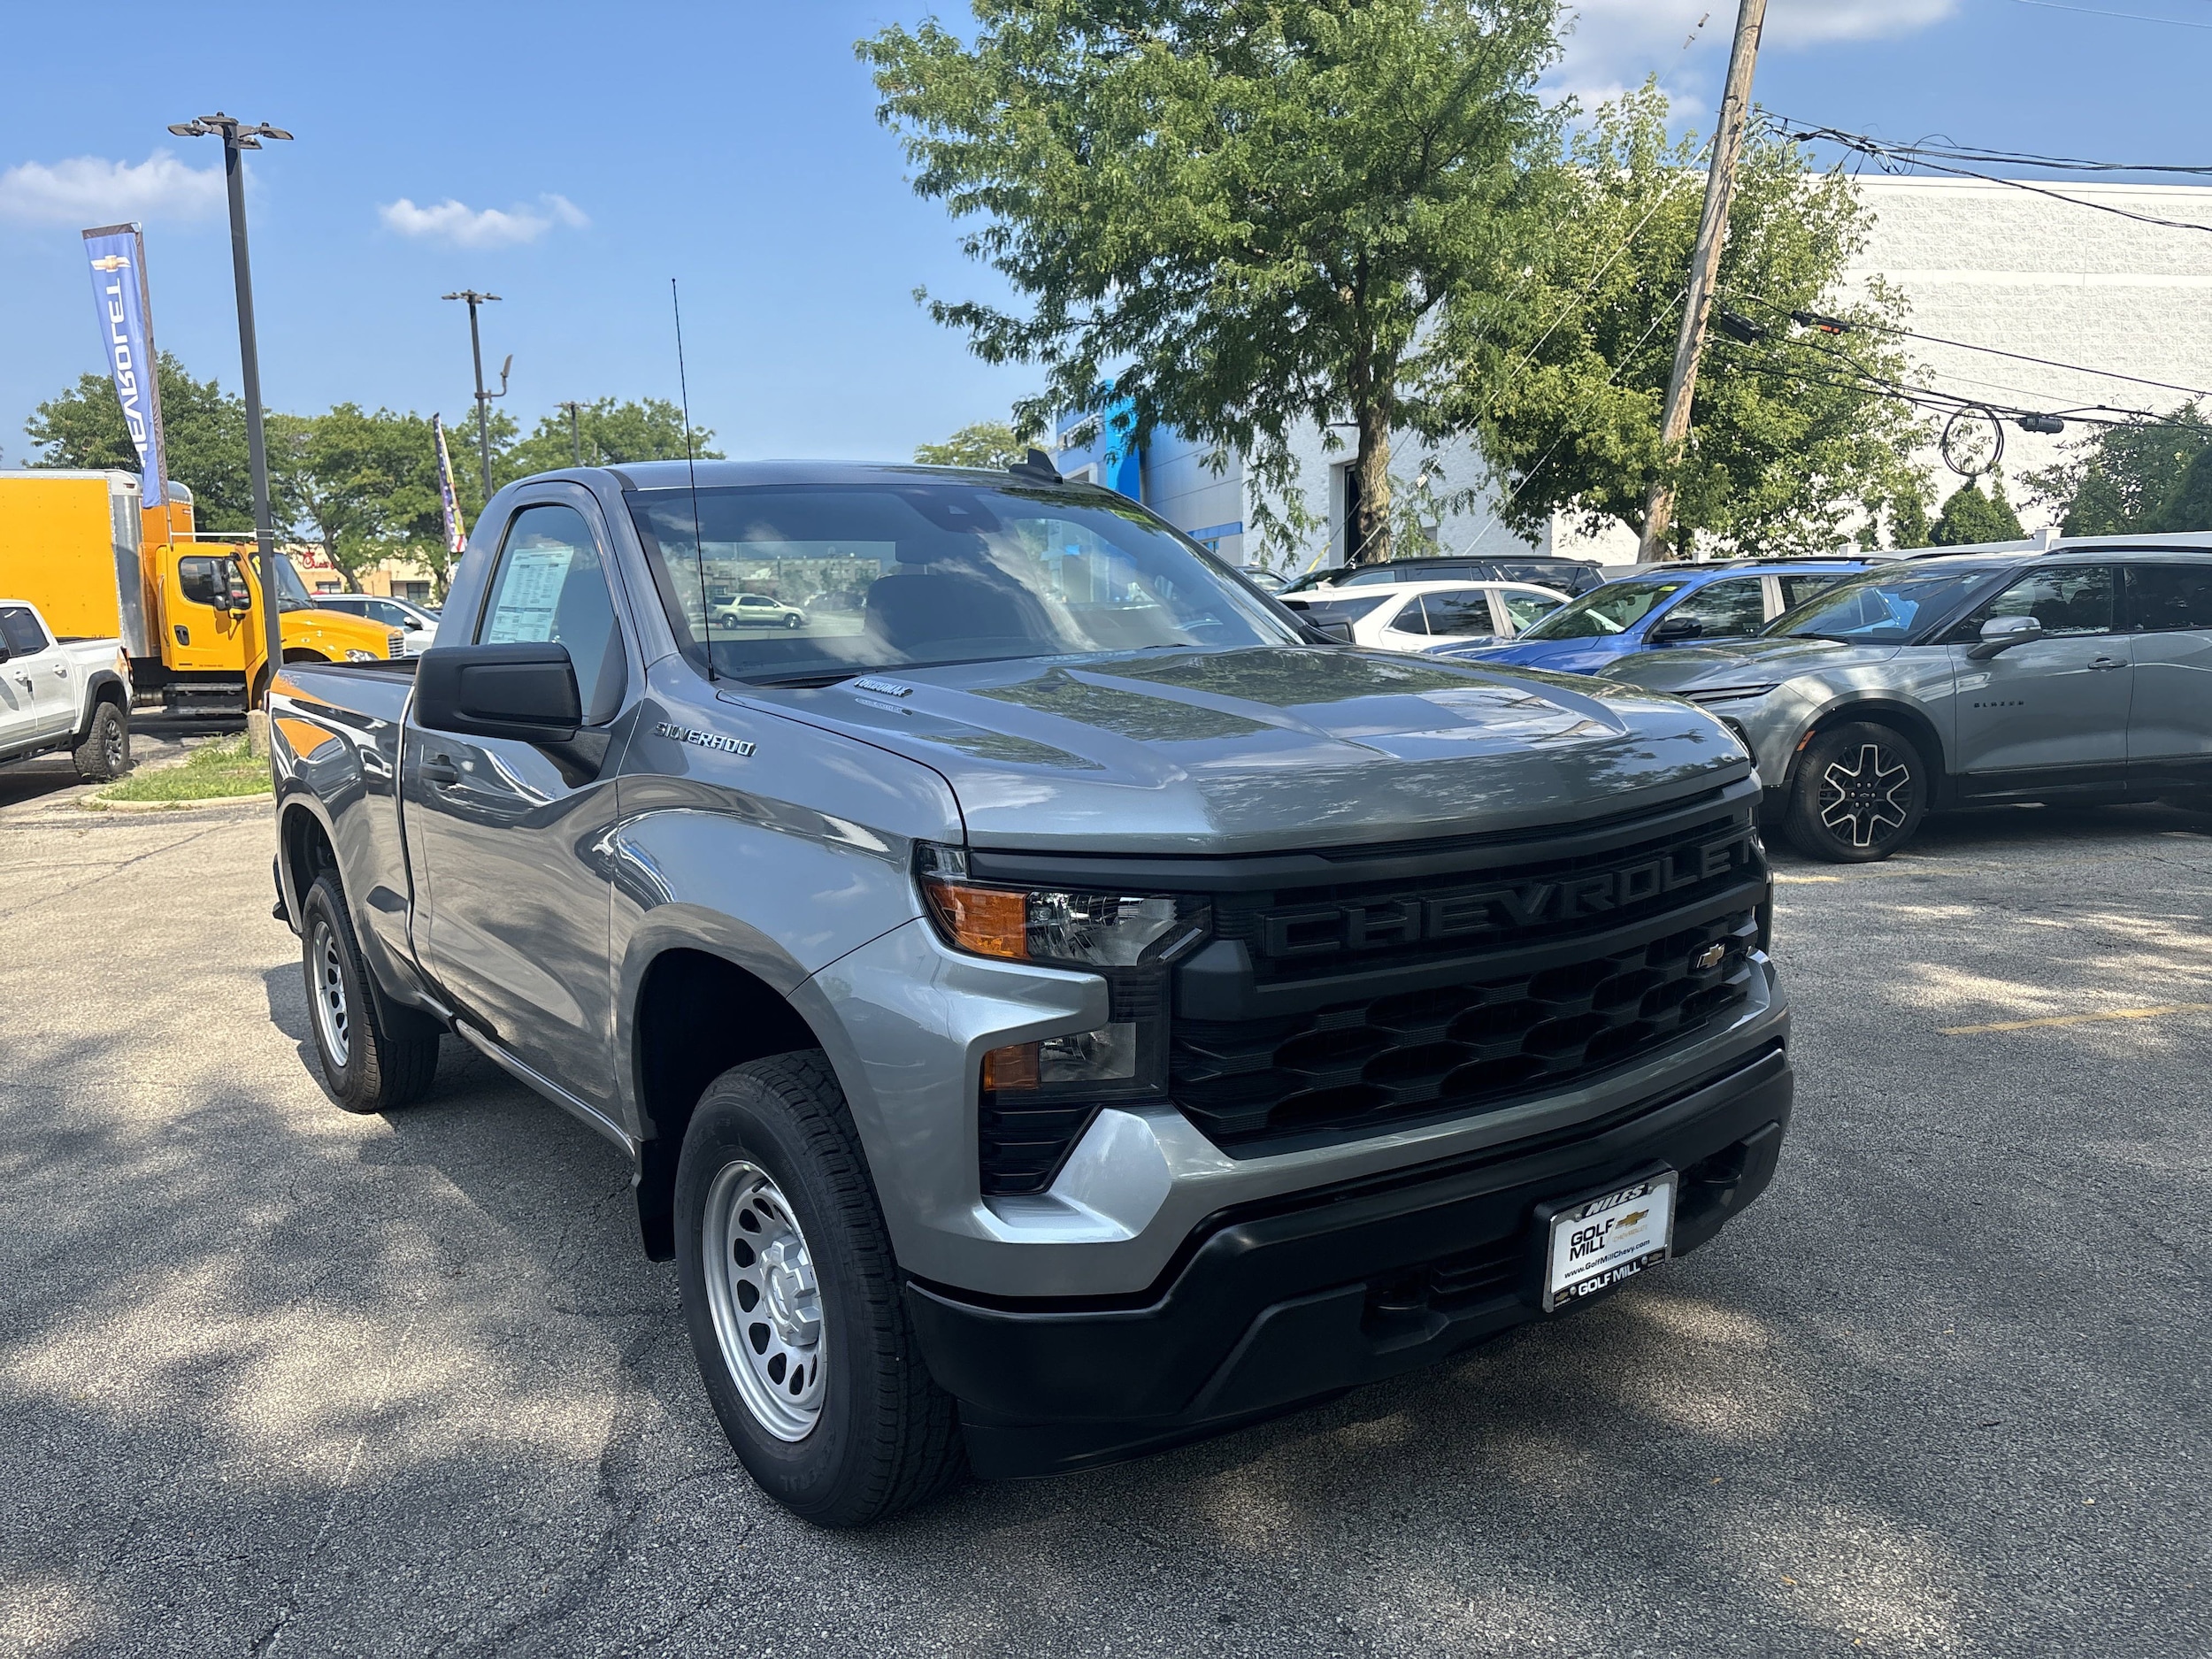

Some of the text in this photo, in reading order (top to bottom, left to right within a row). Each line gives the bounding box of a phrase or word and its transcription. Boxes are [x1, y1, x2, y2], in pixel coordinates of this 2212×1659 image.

[656, 721, 757, 757] SILVERADO
[1262, 826, 1756, 957] CHEVROLET
[1585, 1185, 1646, 1217] NILES
[1570, 1236, 1606, 1262] MILL
[1571, 1217, 1615, 1247] GOLF
[1564, 1239, 1650, 1279] www.GolfMillChevy.com
[1578, 1272, 1611, 1296] GOLF
[1612, 1262, 1641, 1283] MILL
